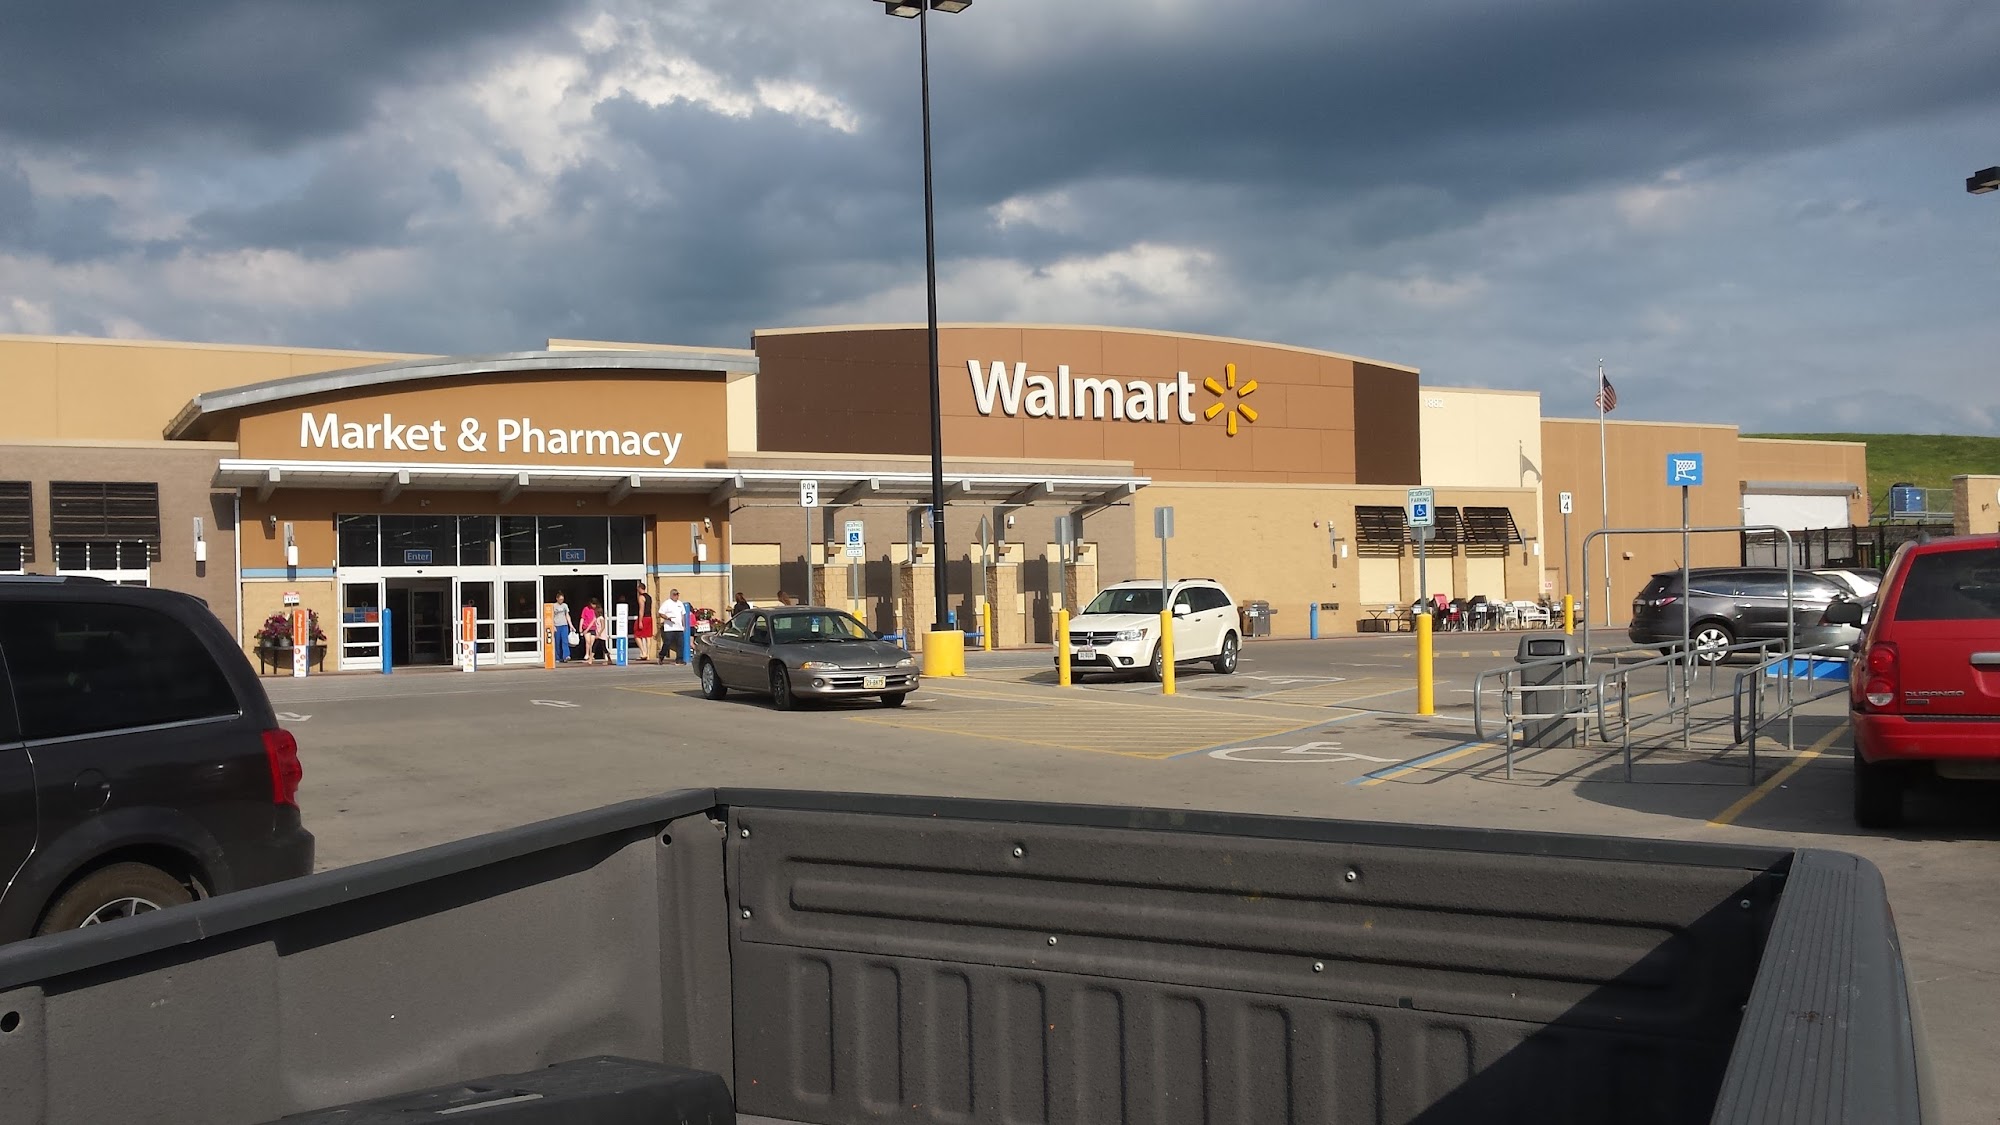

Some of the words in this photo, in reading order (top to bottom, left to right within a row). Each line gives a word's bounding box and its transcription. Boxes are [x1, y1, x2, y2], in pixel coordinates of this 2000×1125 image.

[967, 359, 1196, 424] Walmart
[300, 412, 447, 452] Market
[456, 416, 487, 452] &
[498, 418, 683, 466] Pharmacy
[806, 492, 813, 504] 5
[1563, 501, 1569, 511] 4
[407, 552, 430, 562] Enter
[565, 551, 580, 561] Exit
